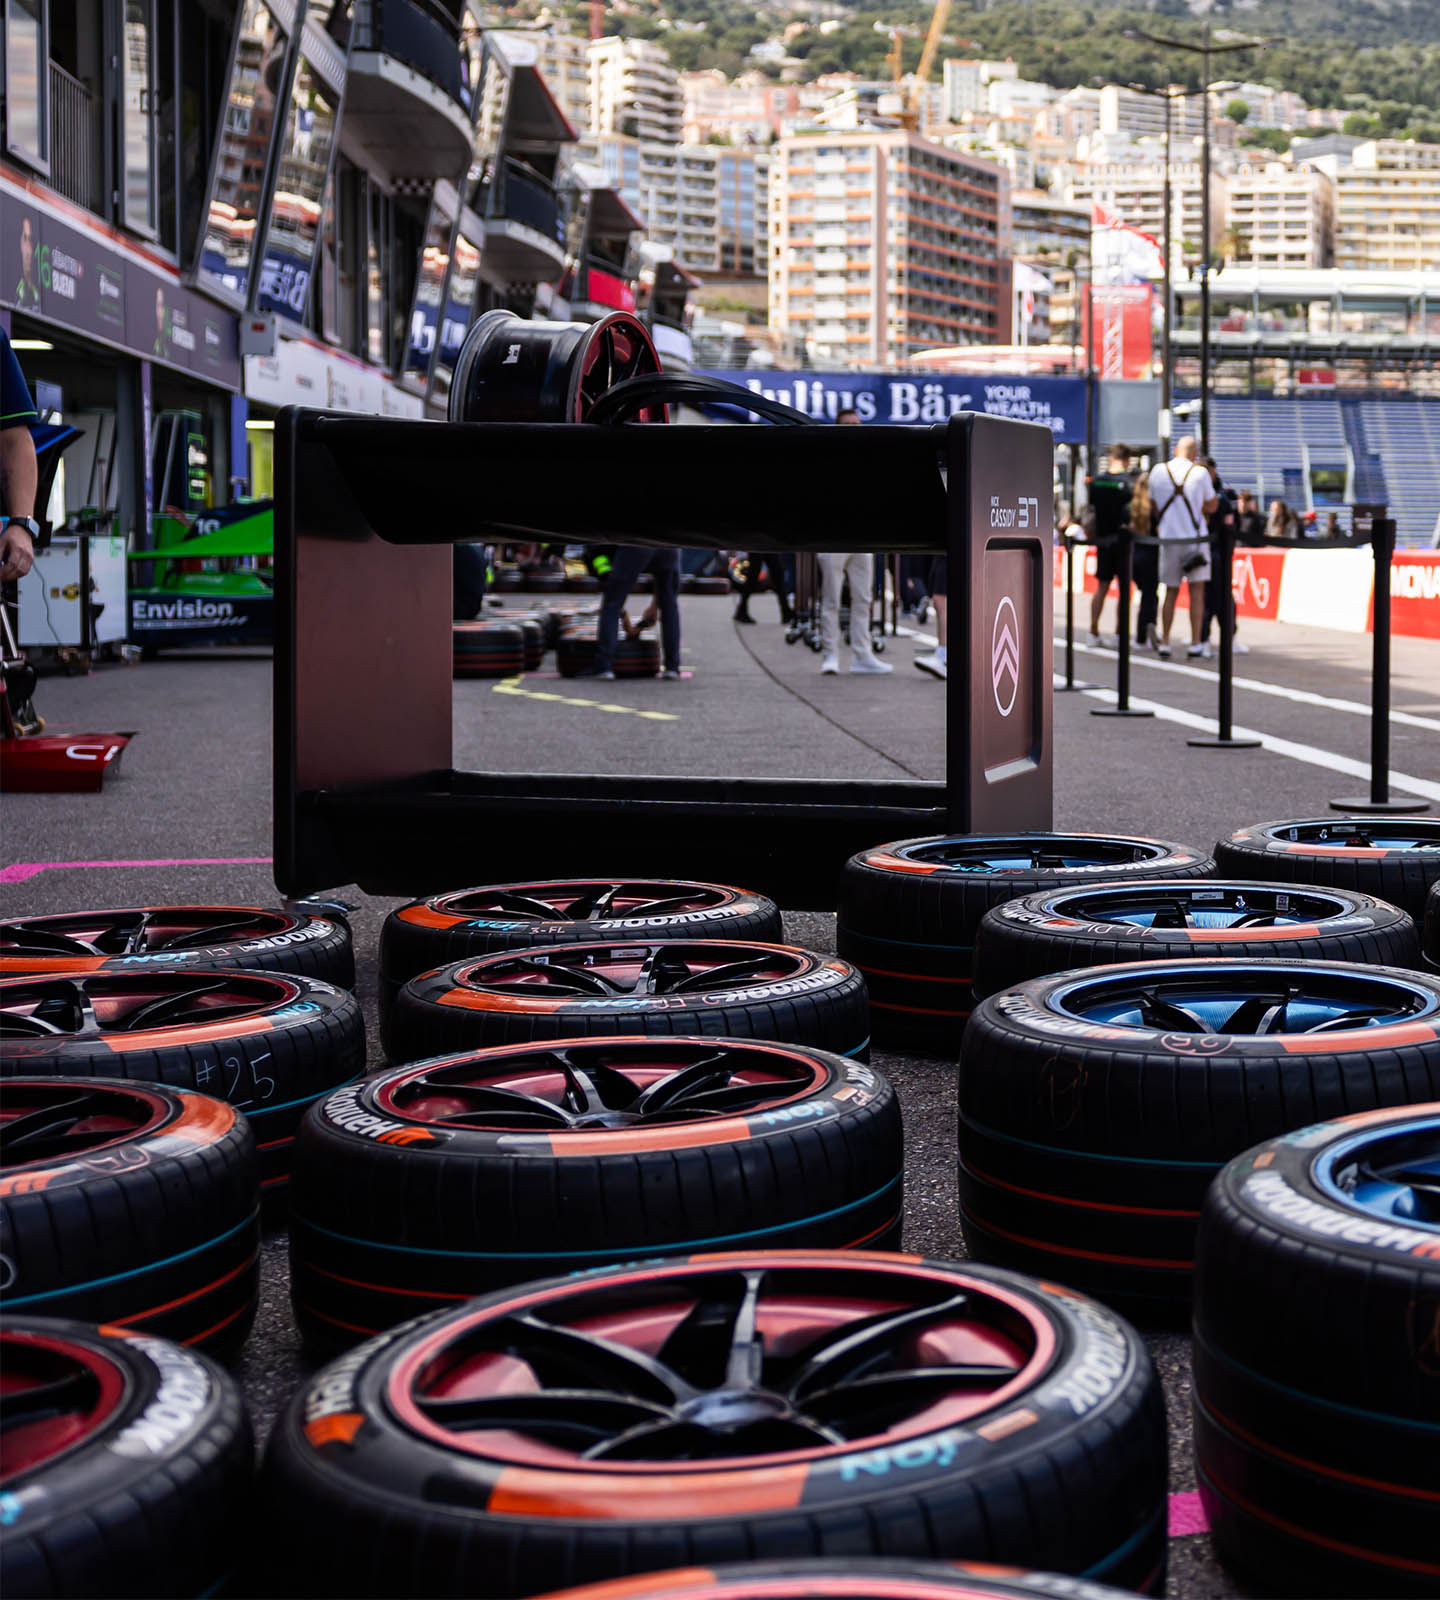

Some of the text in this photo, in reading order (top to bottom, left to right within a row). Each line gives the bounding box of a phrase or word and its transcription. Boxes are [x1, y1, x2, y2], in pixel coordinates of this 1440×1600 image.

[888, 383, 971, 421] Bär
[984, 384, 1031, 401] YOUR
[984, 401, 1051, 418] WEALTH
[990, 508, 1016, 527] CASSIDY
[1018, 497, 1038, 527] 37
[132, 600, 233, 619] Envision
